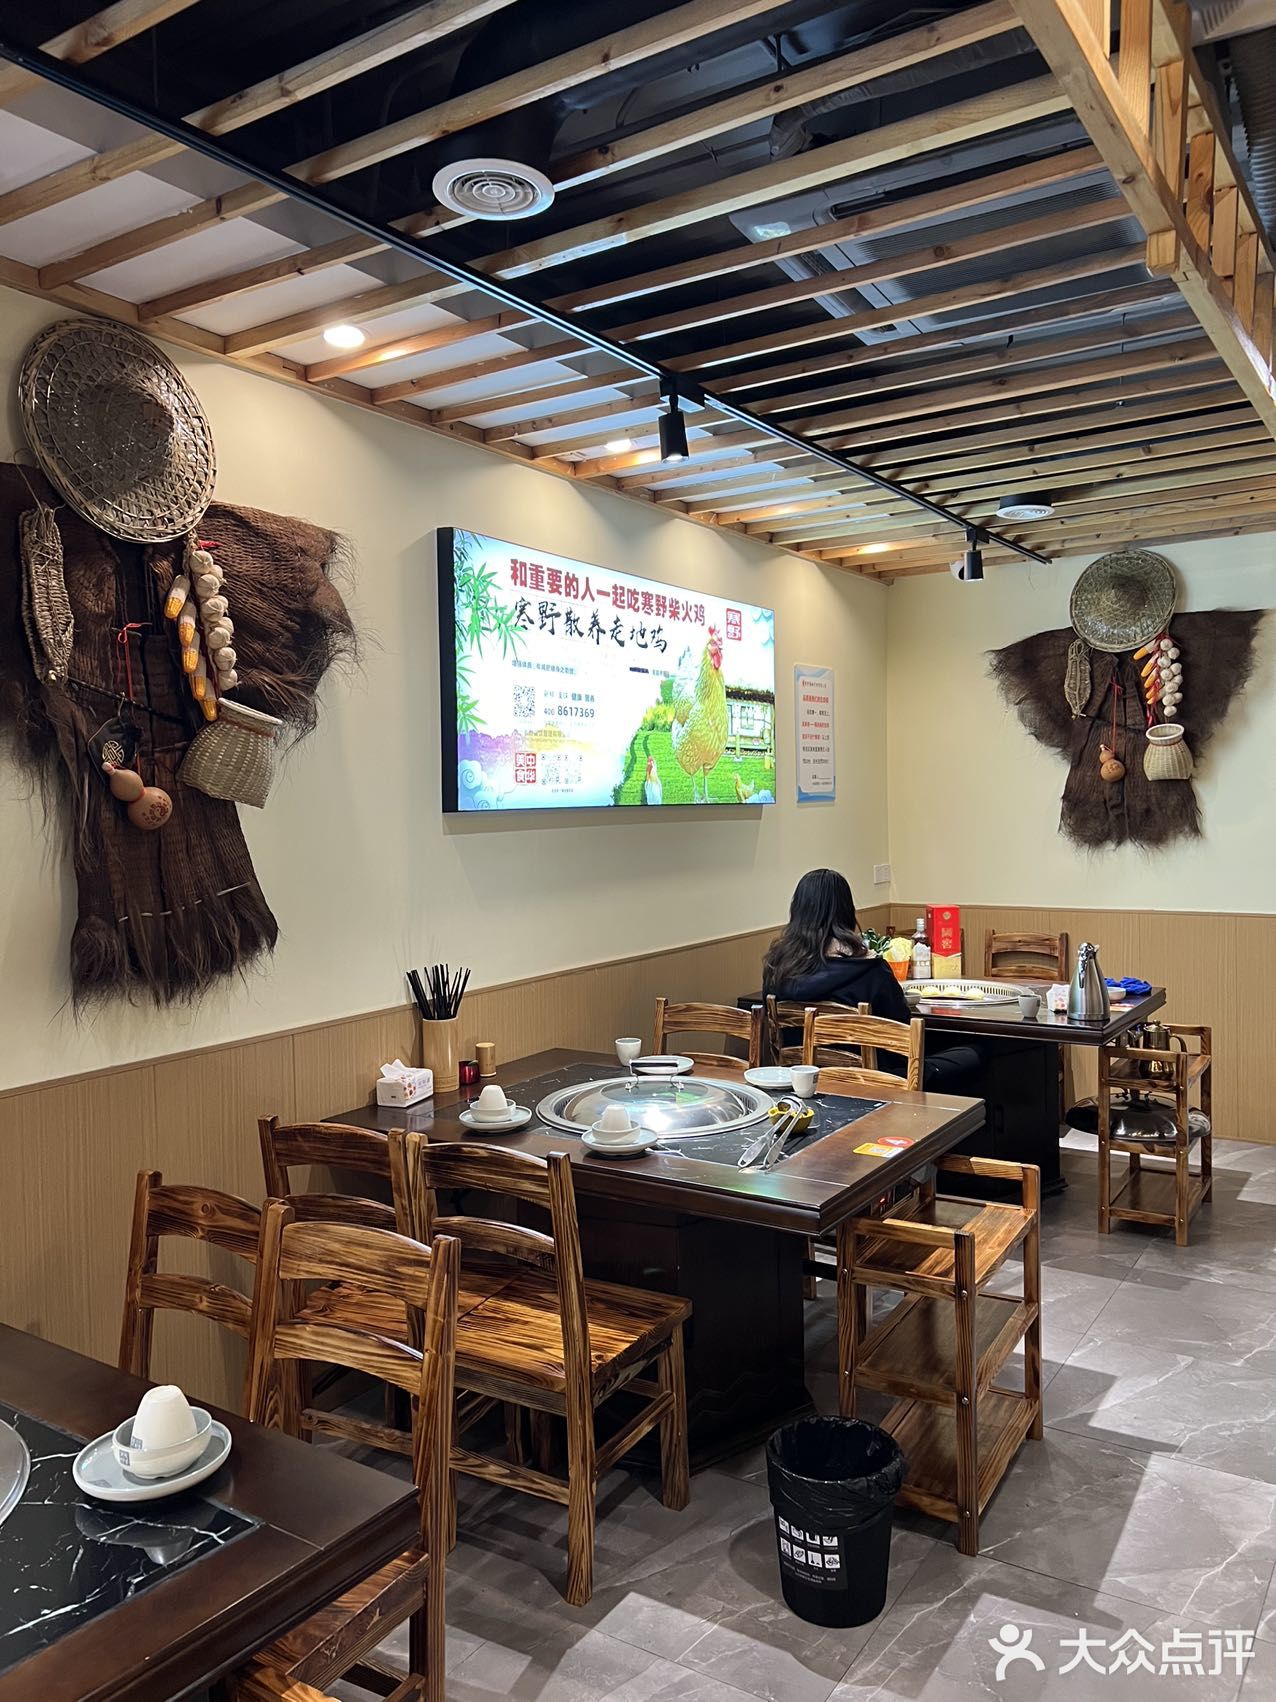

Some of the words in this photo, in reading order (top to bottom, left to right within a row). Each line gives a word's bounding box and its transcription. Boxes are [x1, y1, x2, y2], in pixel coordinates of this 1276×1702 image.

[510, 558, 706, 627] 和重要的人一起吃寒野柴火鸡
[557, 705, 595, 719] 8617369
